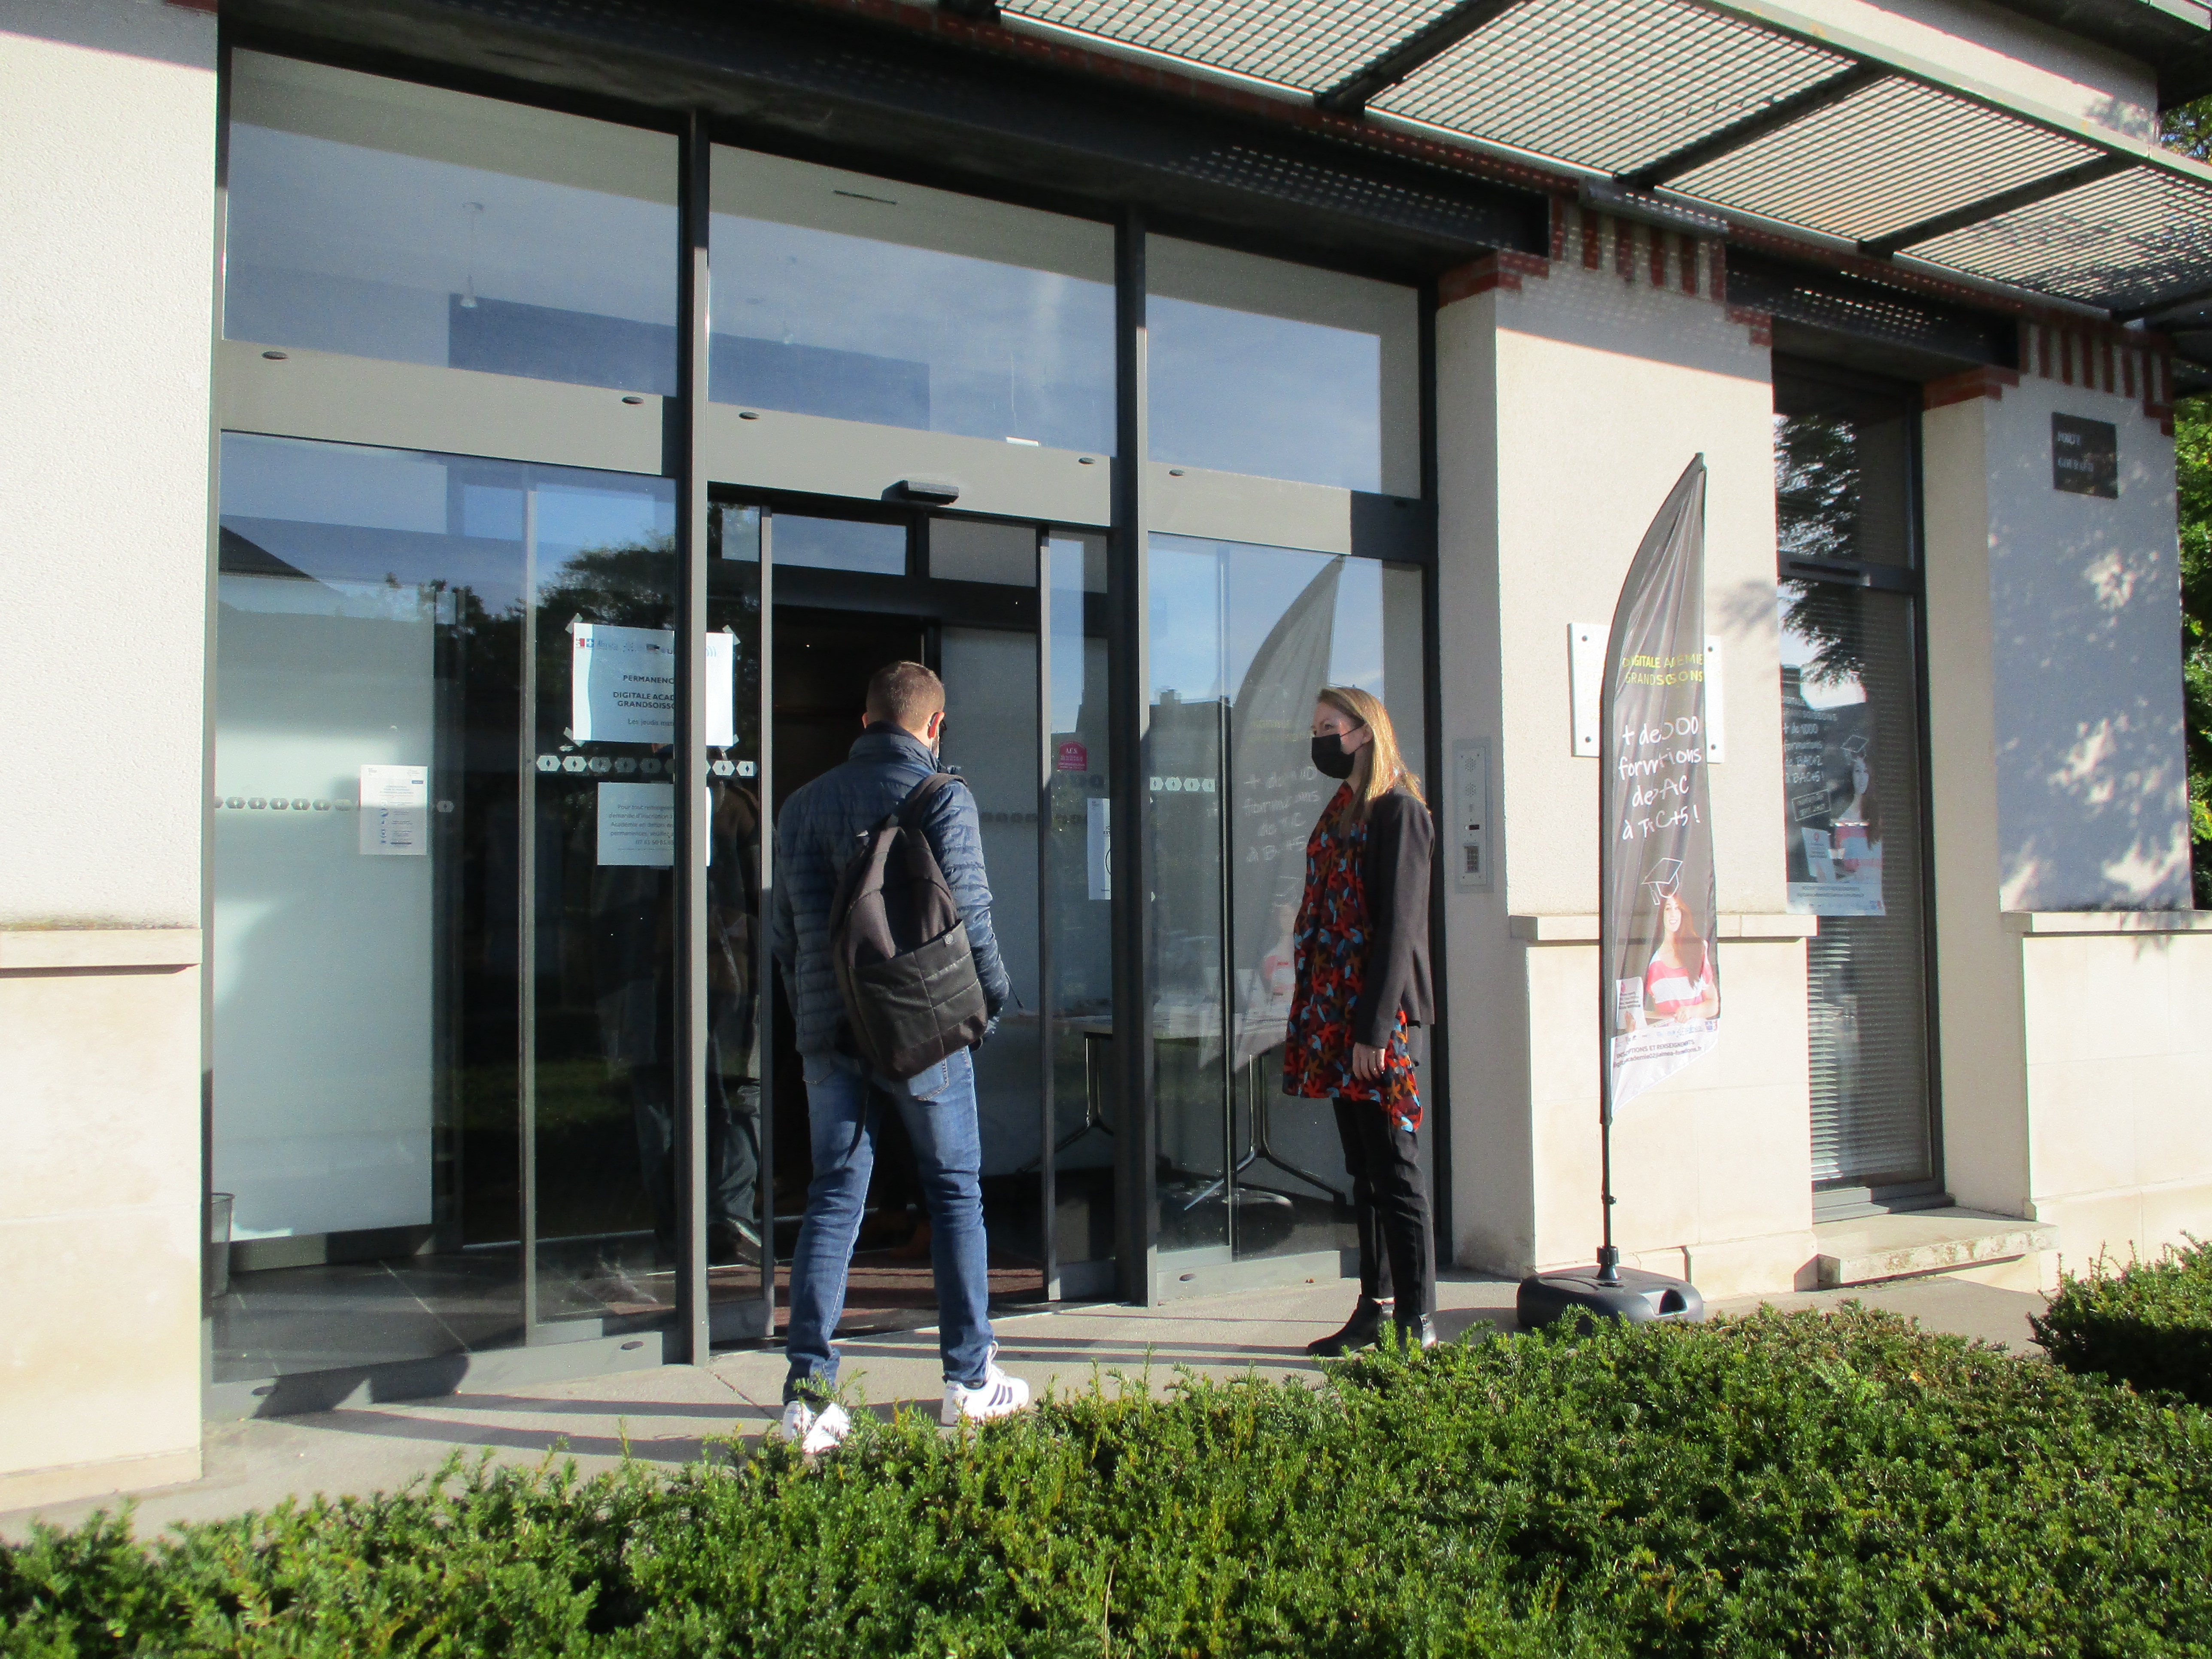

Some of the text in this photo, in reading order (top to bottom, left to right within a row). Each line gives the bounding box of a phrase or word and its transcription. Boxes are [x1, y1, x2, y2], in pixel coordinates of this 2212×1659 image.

[1623, 654, 1661, 668] DIGITALE
[623, 675, 674, 684] PERMANENC
[613, 691, 651, 699] DIGITALE
[617, 700, 674, 709] GRANDSOISSO
[1639, 723, 1662, 745] de
